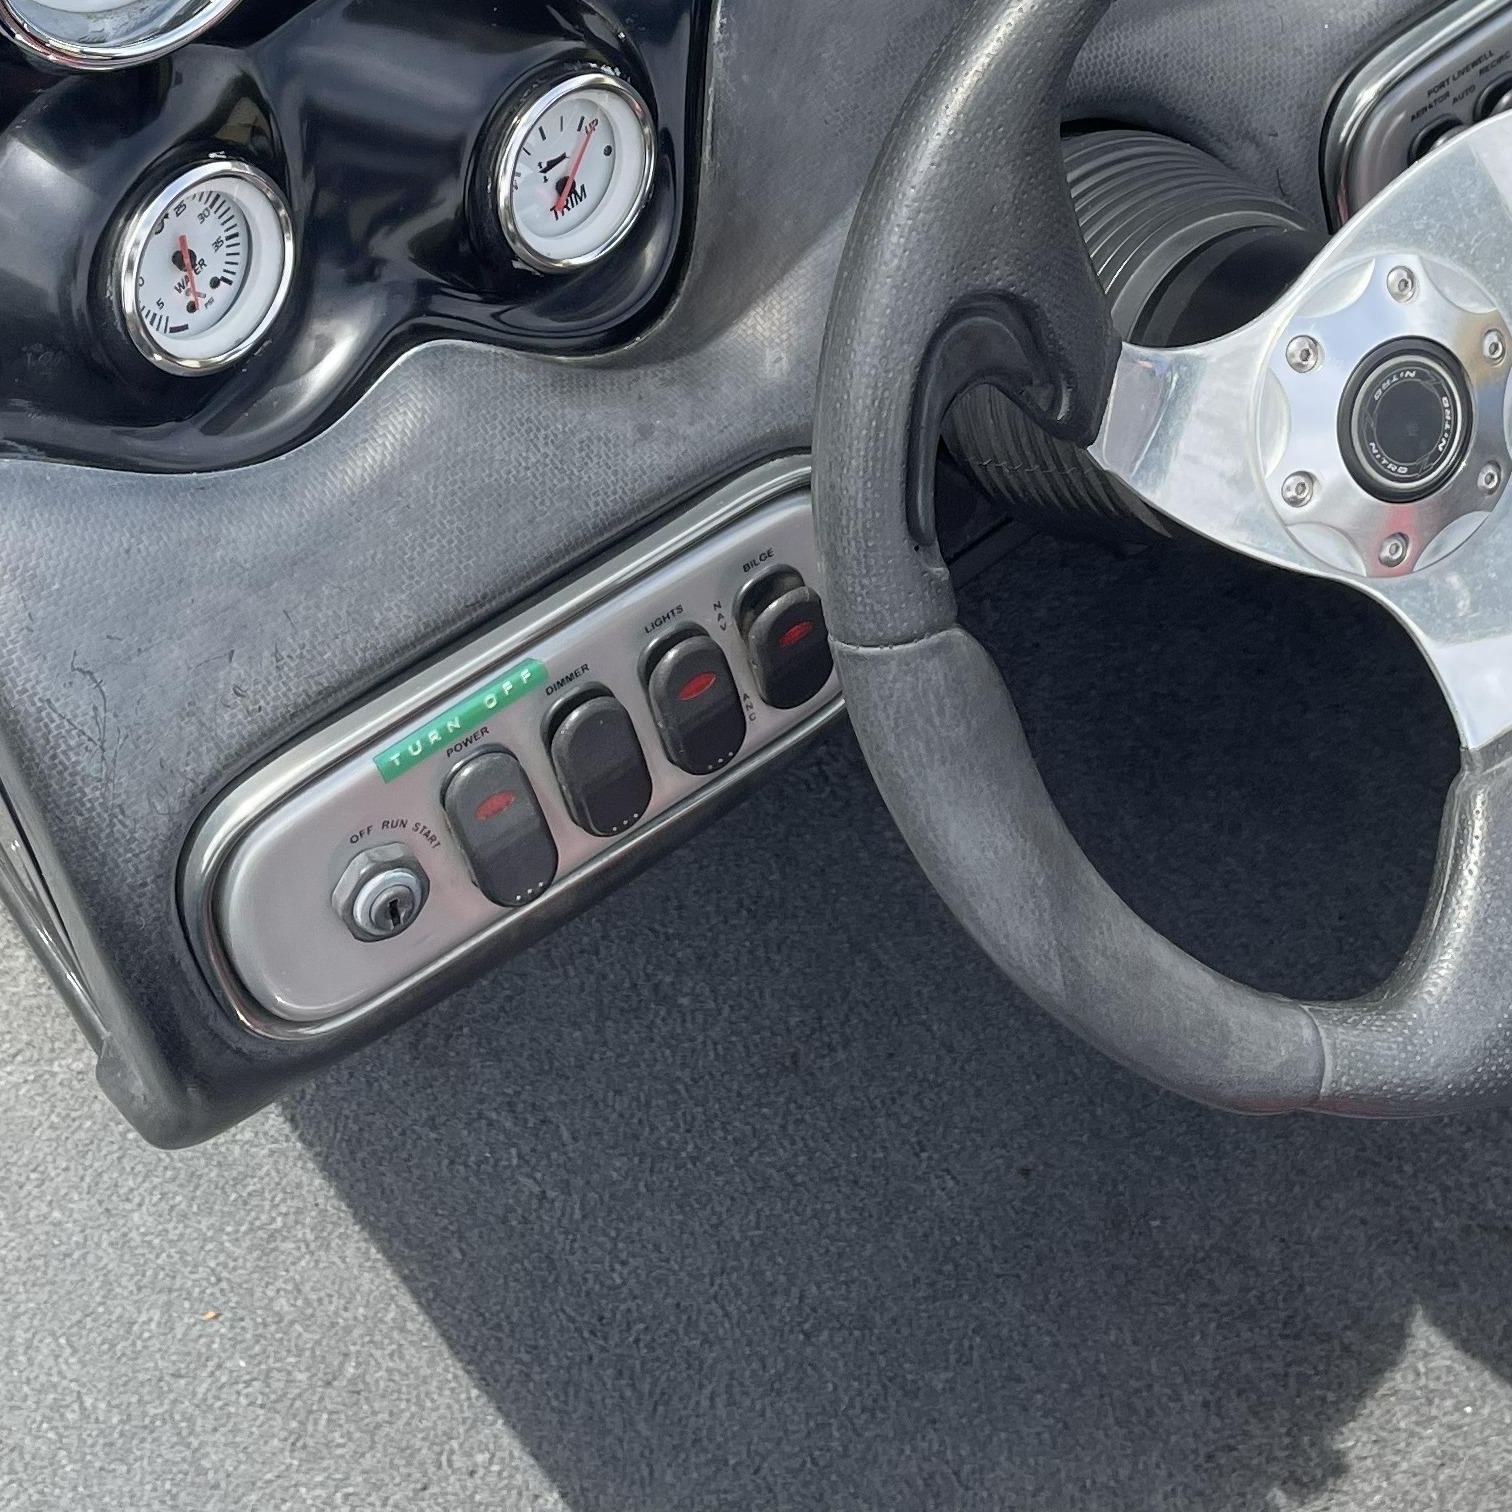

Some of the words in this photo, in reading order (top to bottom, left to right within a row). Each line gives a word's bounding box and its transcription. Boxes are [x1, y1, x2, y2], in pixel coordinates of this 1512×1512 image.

[1427, 77, 1451, 98] PORT
[1452, 49, 1495, 82] LIVEWELL
[1478, 50, 1512, 77] RECIRC
[1410, 90, 1451, 122] AERATOR
[1452, 84, 1477, 106] AUTO
[173, 199, 187, 219] 25
[197, 207, 211, 225] 30
[550, 184, 587, 222] TRIM
[211, 236, 224, 253] 35
[173, 257, 208, 294] WAER
[155, 298, 165, 311] 5
[1373, 370, 1416, 401] NITRO
[1437, 396, 1451, 452] NITRO
[1368, 442, 1408, 473] NITRO
[742, 547, 776, 573] BILGE
[644, 604, 685, 634] LIGHTS
[545, 663, 590, 696] DIMMER
[388, 716, 462, 766] TURN
[483, 668, 532, 709] OFF
[445, 726, 491, 758] POWER
[349, 825, 374, 844] OFF
[381, 818, 408, 830] RUN
[411, 822, 441, 849] START
